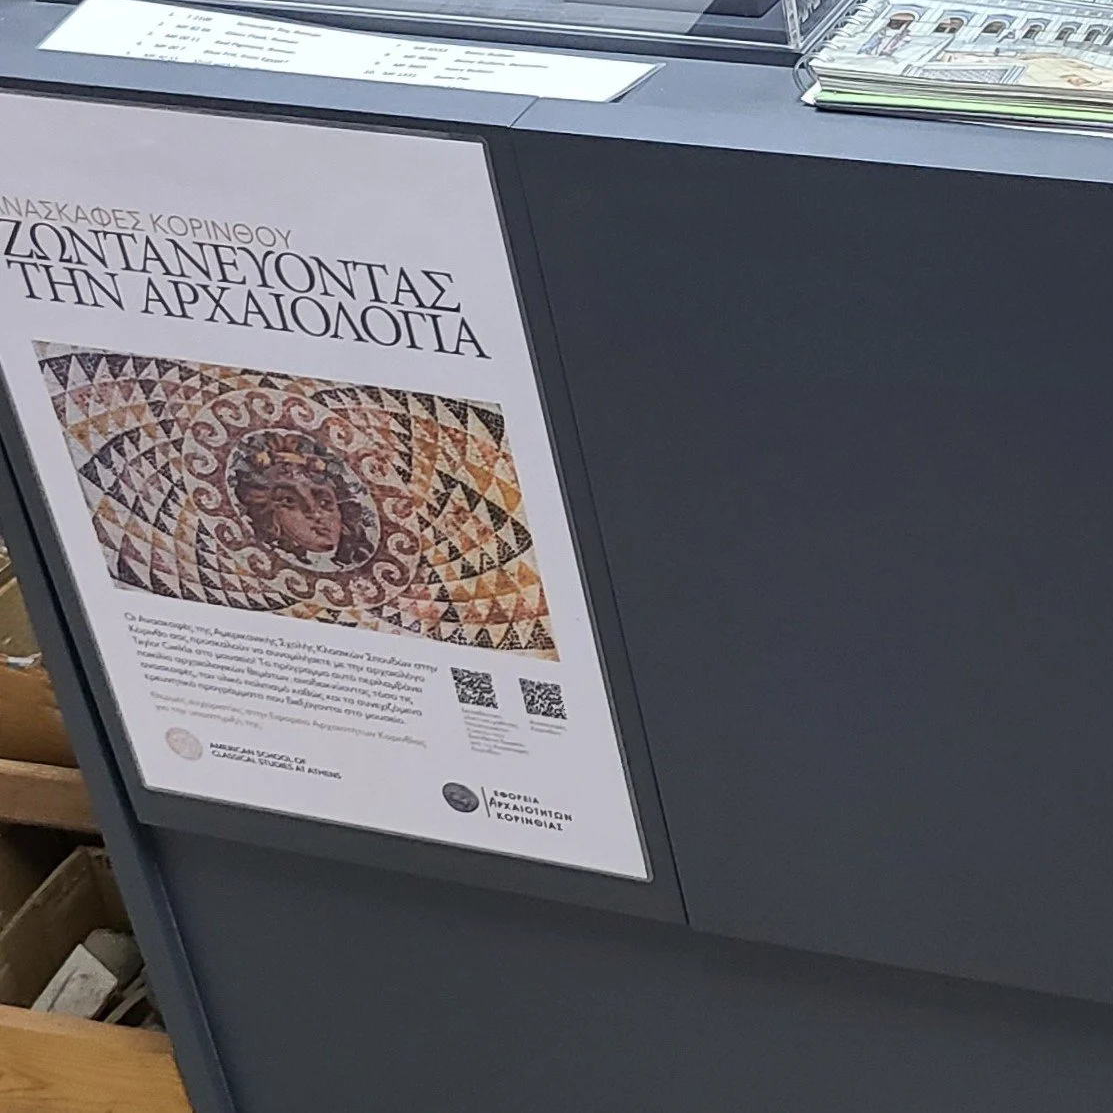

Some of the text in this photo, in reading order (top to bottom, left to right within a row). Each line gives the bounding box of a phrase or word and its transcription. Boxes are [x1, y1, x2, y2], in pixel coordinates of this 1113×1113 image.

[0, 219, 461, 313] ΖΩΝΤΑΝΕΥΟΝΤΑΣ
[150, 213, 292, 249] ΚΟΡΙΝΘΟΥ
[6, 259, 492, 359] ΤΗΝ ΑΡΧΑΙΟΛΟΓΙΑ
